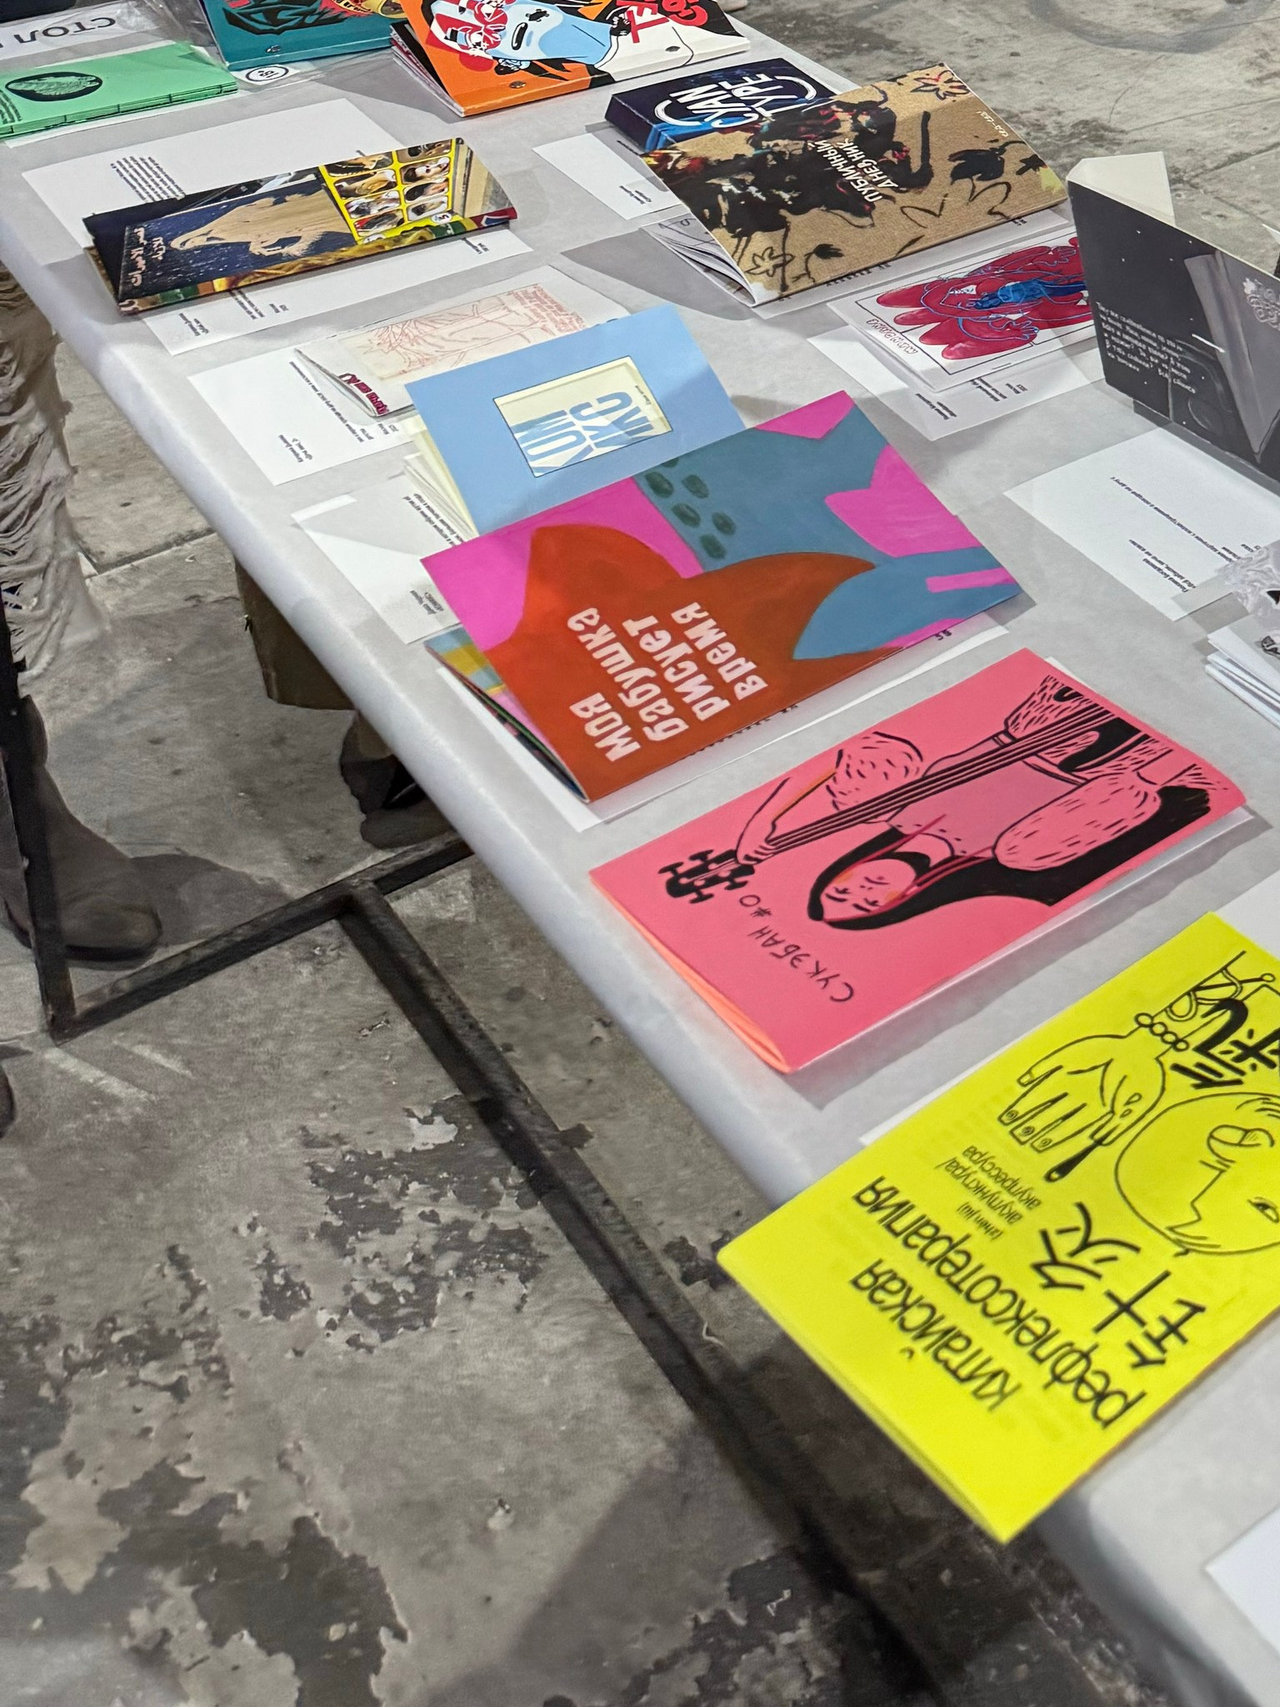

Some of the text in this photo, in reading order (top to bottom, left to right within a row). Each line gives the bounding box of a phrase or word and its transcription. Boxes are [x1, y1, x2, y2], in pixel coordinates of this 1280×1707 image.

[13, 17, 115, 43] СТОЛ
[666, 83, 748, 130] CYAN
[732, 72, 790, 126] TYPE
[806, 138, 882, 204] ПУБЛИЧНЫЙ
[836, 136, 898, 190] ДНЕВНИК
[564, 608, 689, 744] бабушка
[620, 612, 730, 722] рисует
[669, 599, 768, 701] время
[748, 926, 855, 1004] СУКЭБАН
[848, 1253, 1022, 1413] китайская
[849, 1172, 1145, 1431] рефлексотерапия
